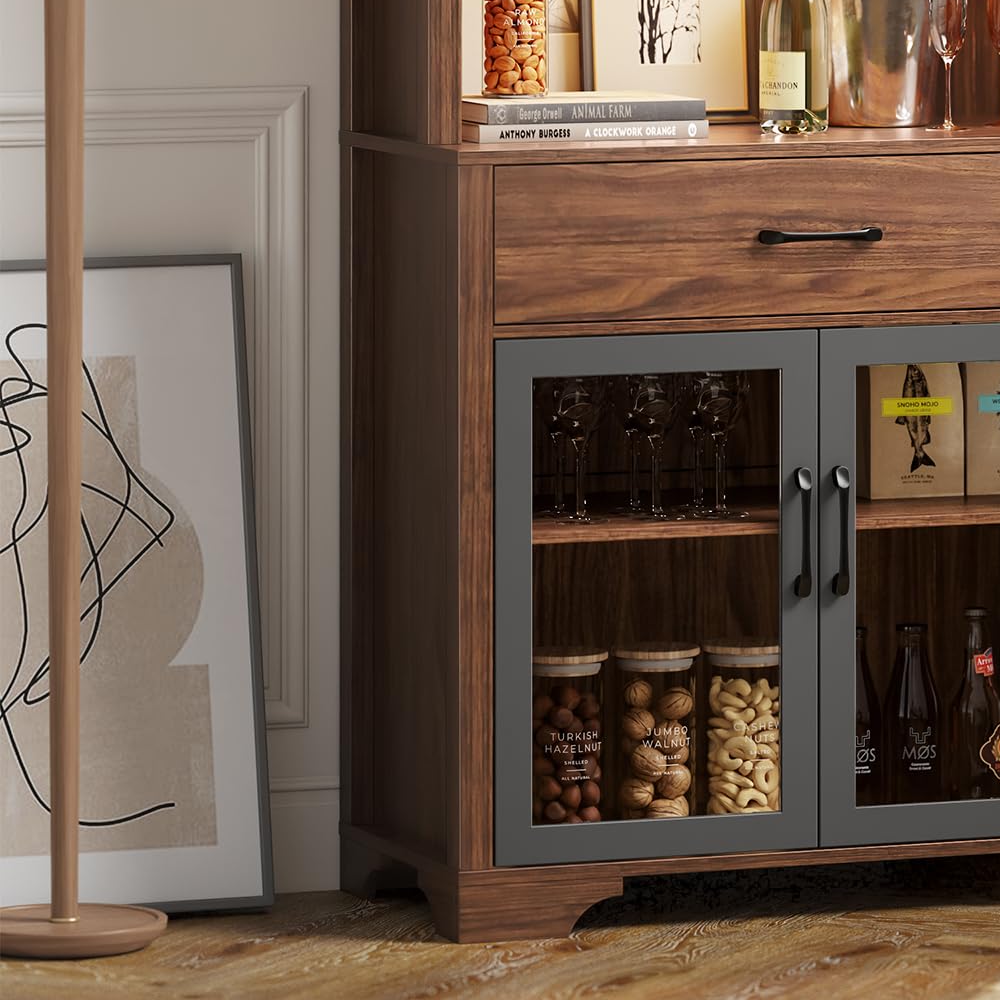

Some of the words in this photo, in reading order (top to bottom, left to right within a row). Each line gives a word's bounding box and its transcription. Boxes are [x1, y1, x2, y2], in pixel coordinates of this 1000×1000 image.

[514, 8, 537, 16] RAW
[503, 18, 545, 26] ALMOND
[765, 82, 798, 90] CHANDON
[519, 107, 541, 122] George
[542, 107, 563, 120] Orwell
[571, 103, 607, 119] ANIMAL
[608, 104, 633, 119] FARM
[499, 129, 536, 139] ANTHONY
[538, 128, 571, 138] BURGESS
[584, 128, 591, 138] A
[593, 126, 643, 138] CLOCKWORK
[645, 126, 677, 137] ORANGE
[550, 730, 598, 741] TURKISH
[646, 725, 688, 737] JUMBO
[642, 737, 691, 749] WALNUT
[744, 733, 775, 744] NUTS
[544, 741, 602, 754] HAZELNUT
[902, 744, 937, 760] MØS
[856, 747, 876, 763] ØS
